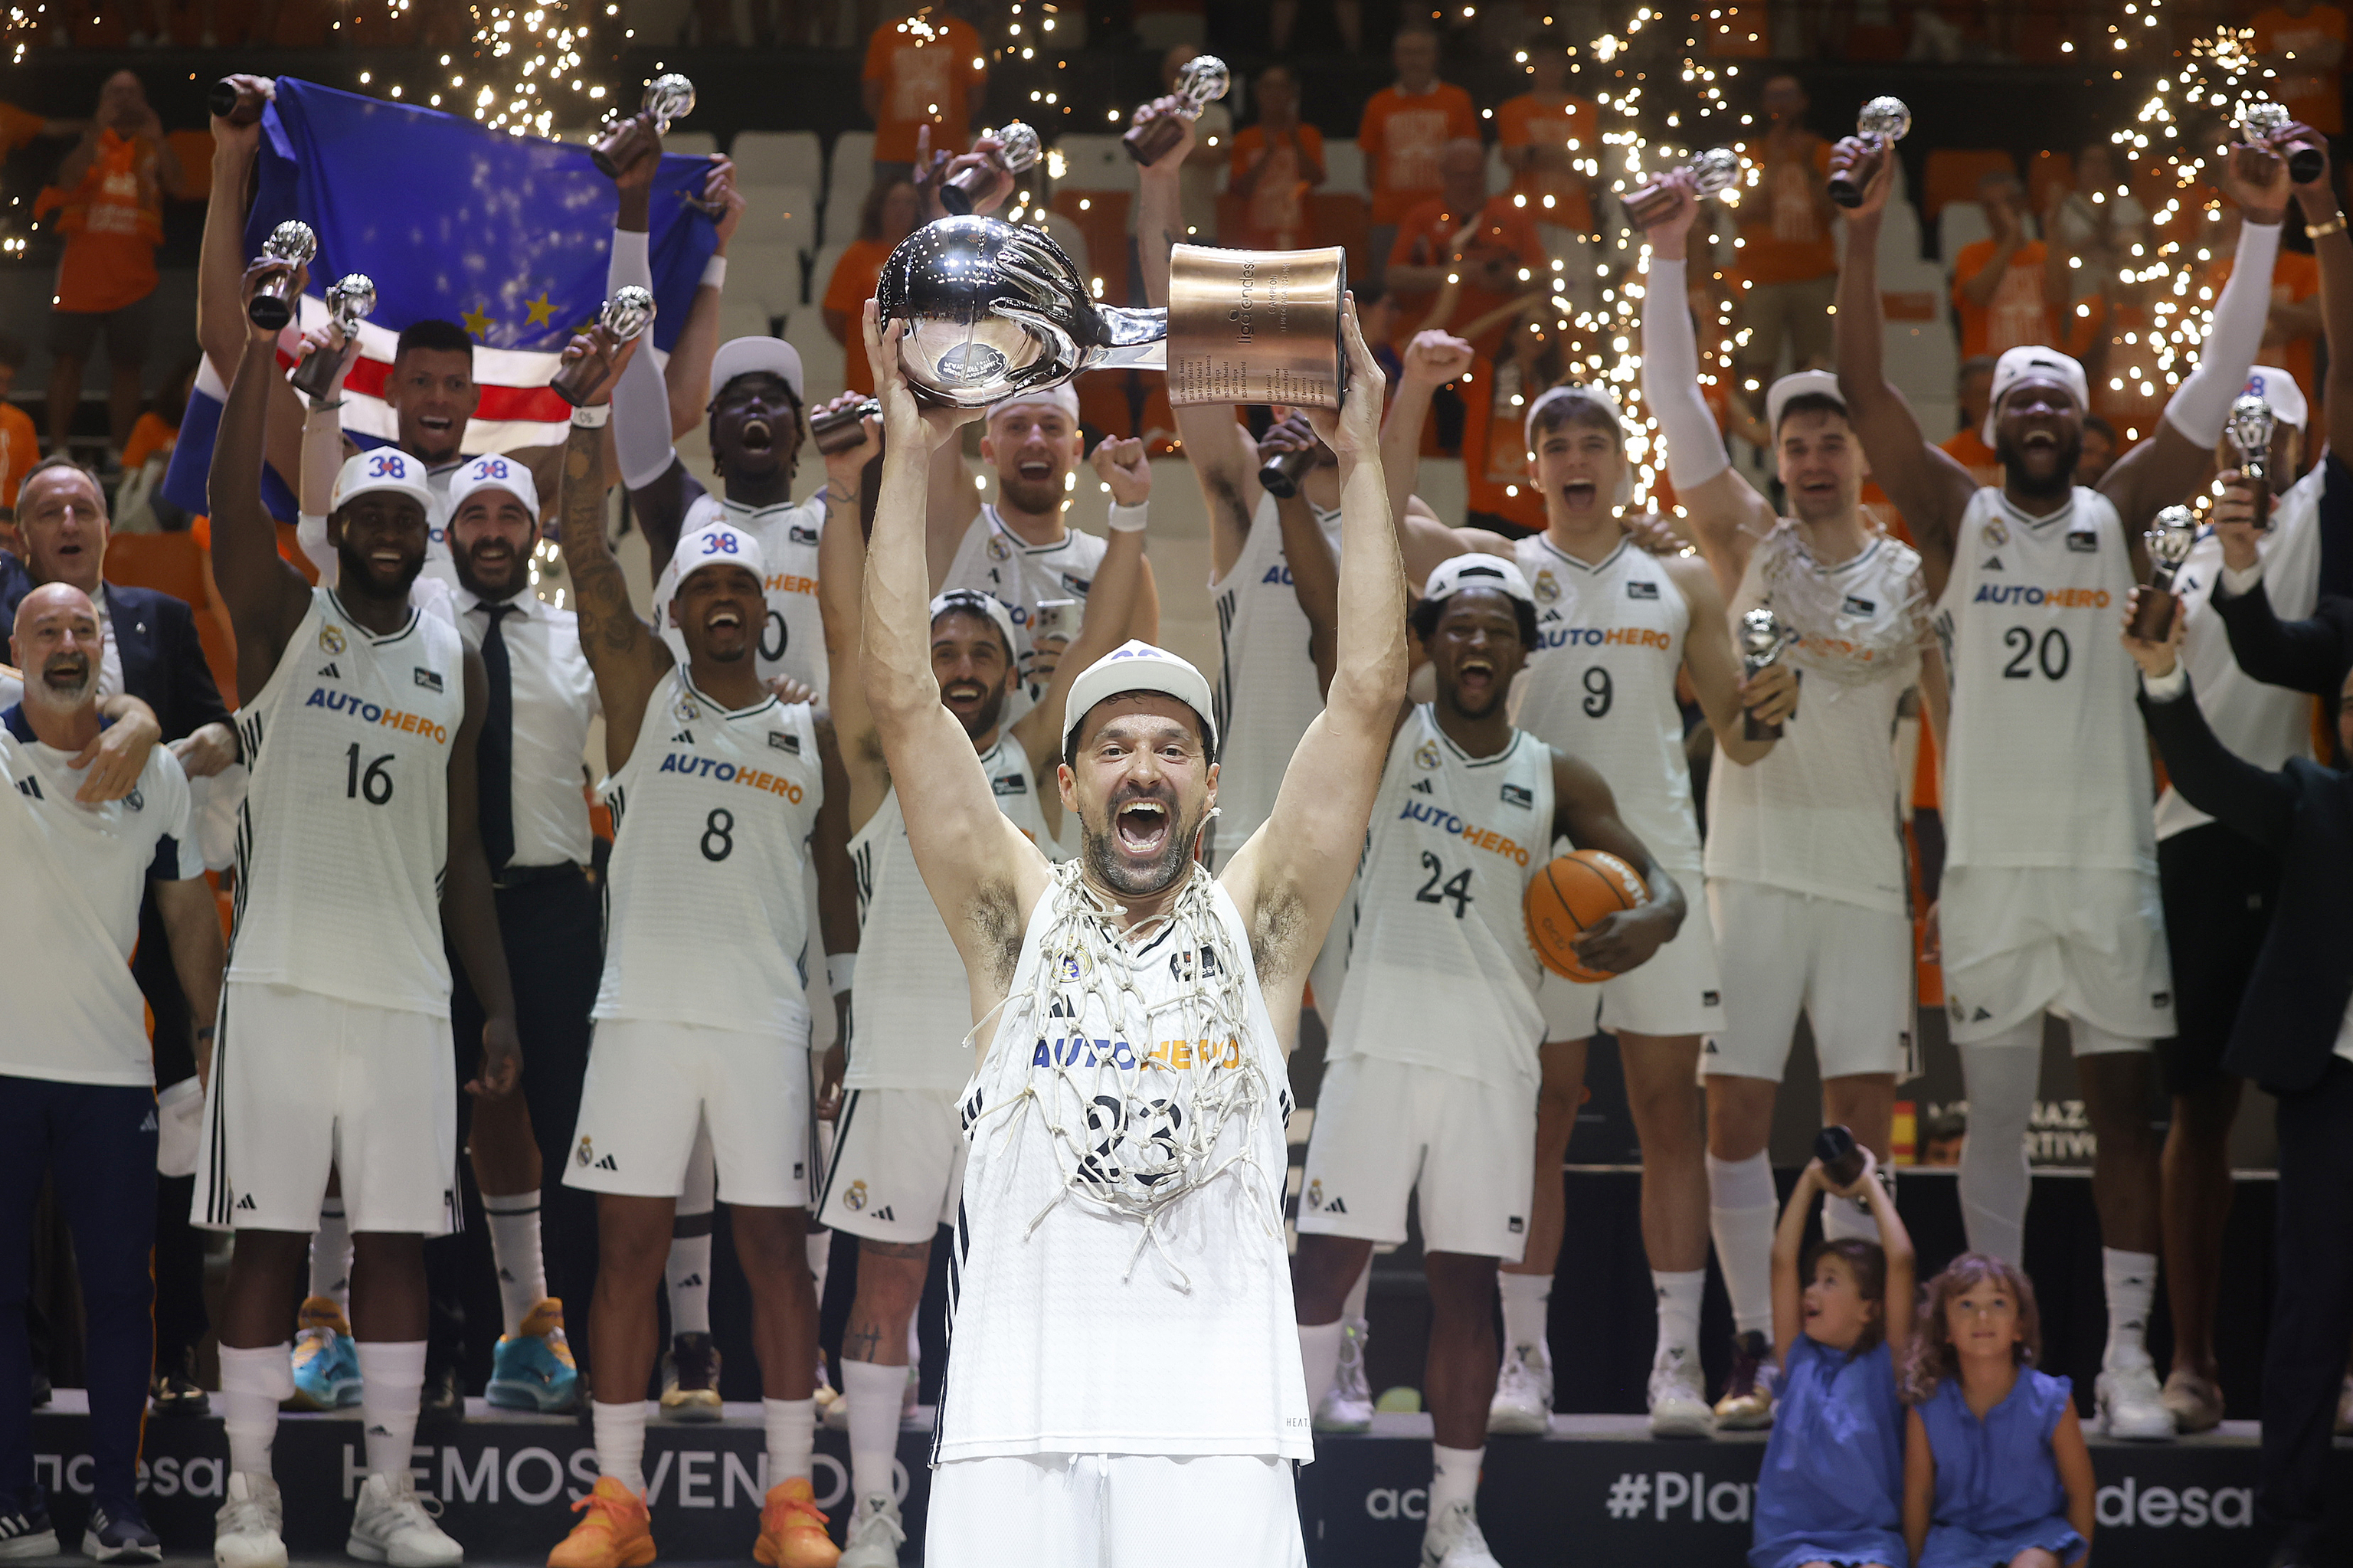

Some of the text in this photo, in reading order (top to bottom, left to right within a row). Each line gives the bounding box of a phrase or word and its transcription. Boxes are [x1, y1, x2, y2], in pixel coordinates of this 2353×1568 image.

[1267, 274, 1277, 314] CAMPEÓN
[1237, 313, 1254, 344] liga
[369, 456, 406, 479] 38
[473, 460, 508, 480] 38
[702, 532, 739, 555] 38
[1974, 583, 2111, 611] AUTOHERO
[1536, 627, 1672, 650] AUTOHERO
[2003, 625, 2070, 680] 20
[305, 686, 447, 745] AUTOHERO
[1582, 666, 1612, 719] 9
[345, 741, 396, 806] 16
[659, 751, 803, 806] AUTOHERO
[701, 807, 735, 863] 8
[1399, 798, 1531, 868] AUTOHERO
[1416, 849, 1474, 918] 24
[1028, 1038, 1239, 1071] AUTOHERO
[1077, 1095, 1182, 1187] 23
[342, 1443, 599, 1506] HEMOS
[1605, 1471, 1757, 1523] #Pla
